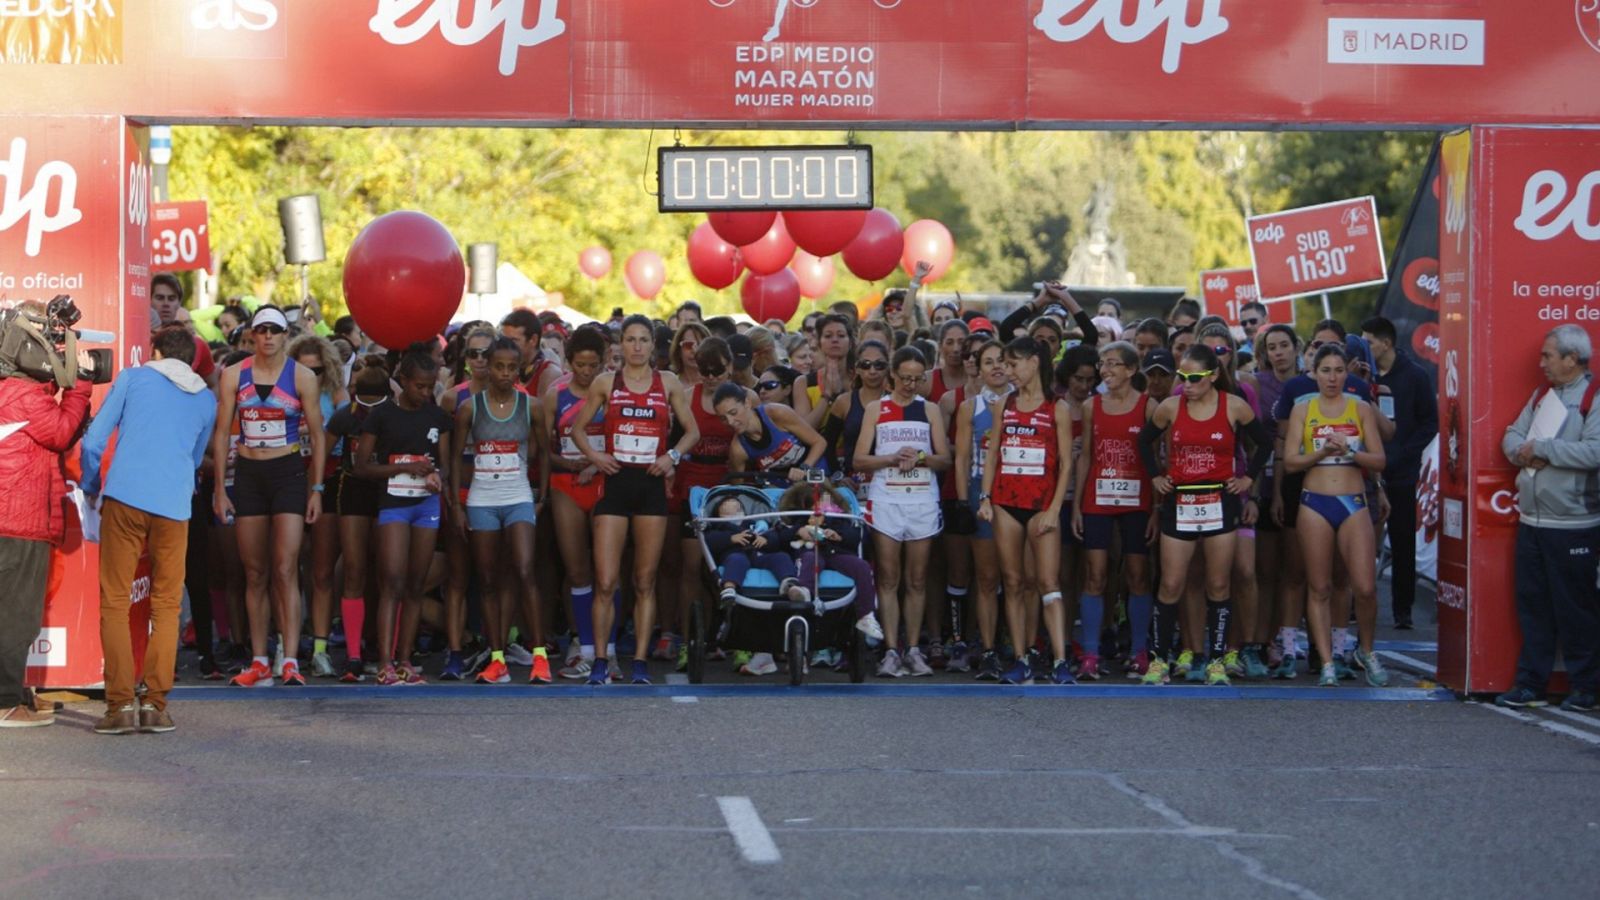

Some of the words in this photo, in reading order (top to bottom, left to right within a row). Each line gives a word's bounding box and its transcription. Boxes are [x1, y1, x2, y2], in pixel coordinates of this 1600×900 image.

[190, 0, 278, 31] as
[1373, 32, 1469, 51] MADRID
[736, 46, 785, 62] EDP
[794, 47, 874, 63] MEDIO
[735, 65, 875, 89] MARATÓN
[735, 93, 794, 106] MUJER
[801, 93, 875, 107] MADRID
[1255, 222, 1285, 244] edp
[1296, 230, 1331, 252] SUB
[22, 272, 83, 289] oficial
[1206, 275, 1229, 291] edp
[1513, 281, 1531, 297] la
[1537, 281, 1600, 300] energí
[1538, 305, 1568, 321] del
[1575, 305, 1600, 321] de
[243, 409, 260, 421] edp
[634, 408, 653, 418] BM
[260, 423, 267, 433] 5
[1017, 426, 1036, 436] BM
[634, 438, 640, 447] 1
[495, 455, 501, 466] 3
[1019, 449, 1026, 459] 2
[901, 468, 920, 479] 106
[1110, 481, 1129, 491] 122
[1194, 506, 1207, 517] 35
